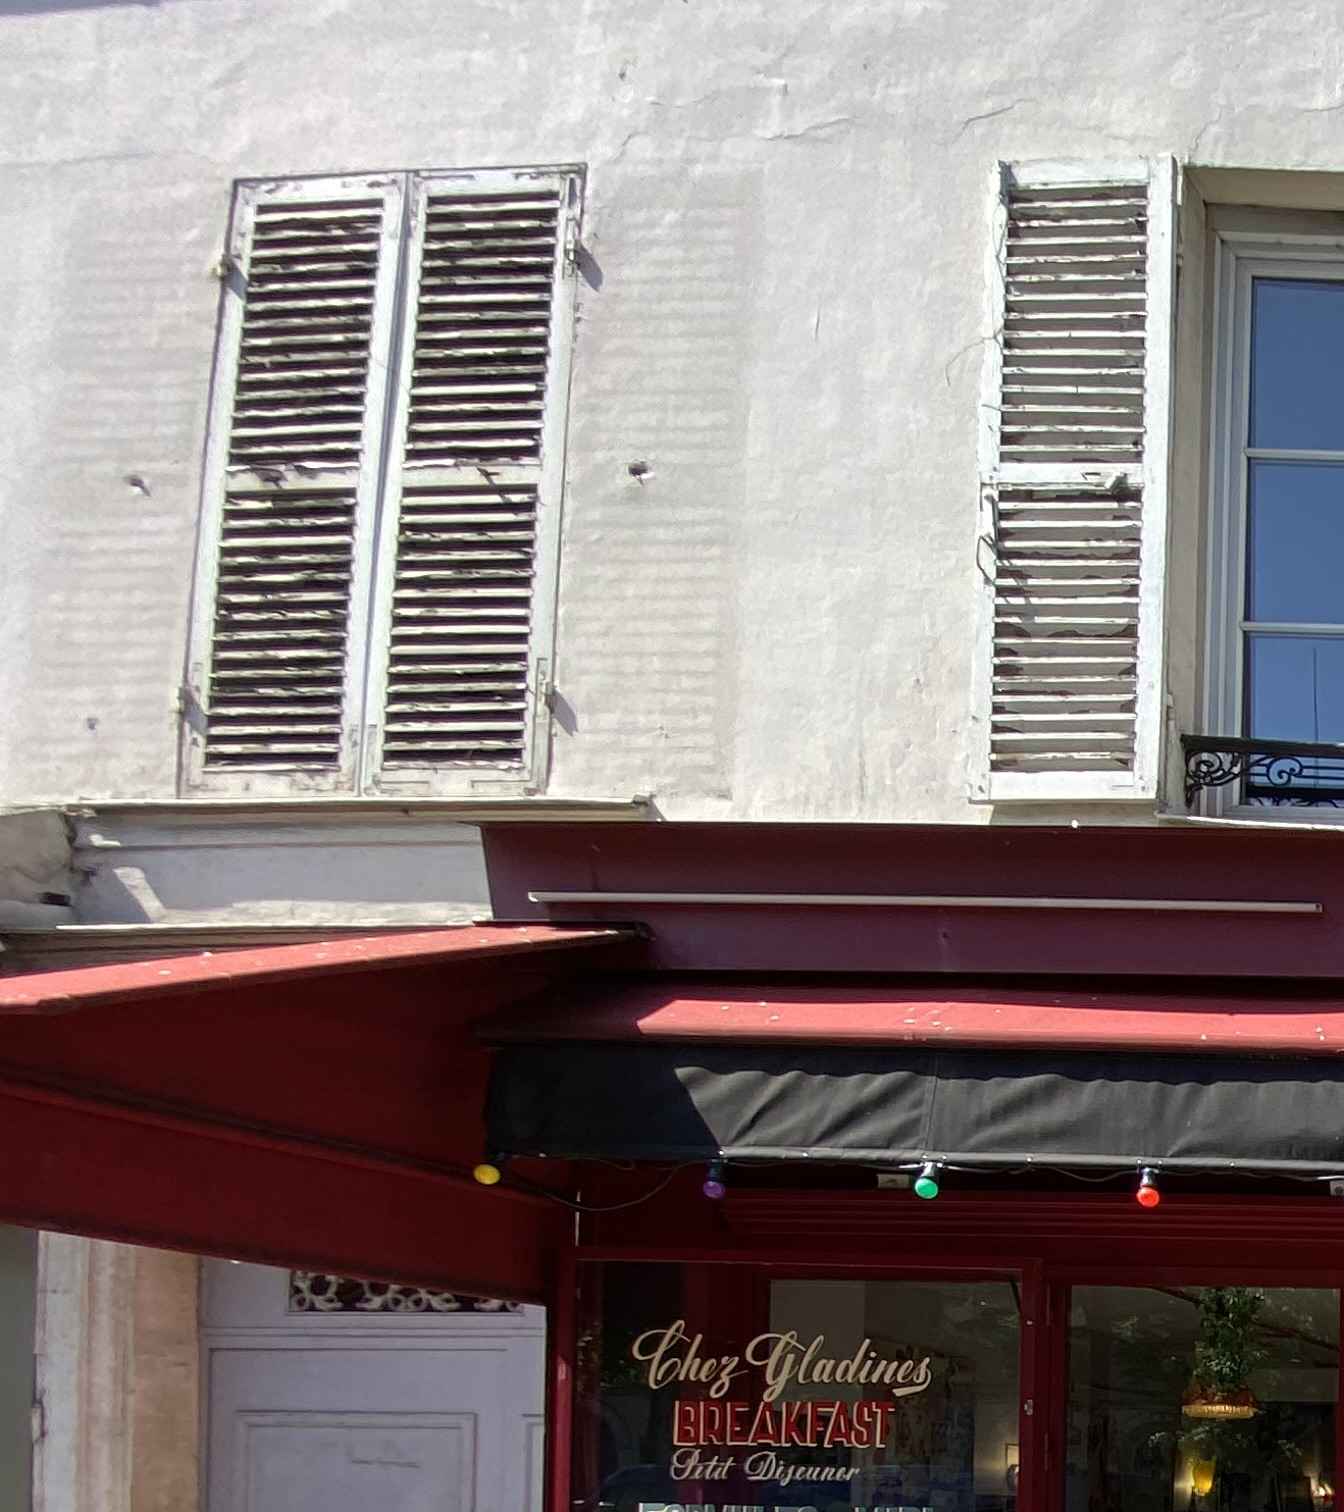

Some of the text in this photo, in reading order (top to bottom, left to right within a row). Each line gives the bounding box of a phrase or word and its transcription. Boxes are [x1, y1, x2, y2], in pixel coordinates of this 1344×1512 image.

[632, 1320, 931, 1401] Chez Gladines
[673, 1401, 895, 1448] BREAKFAST
[670, 1448, 736, 1481] Petit
